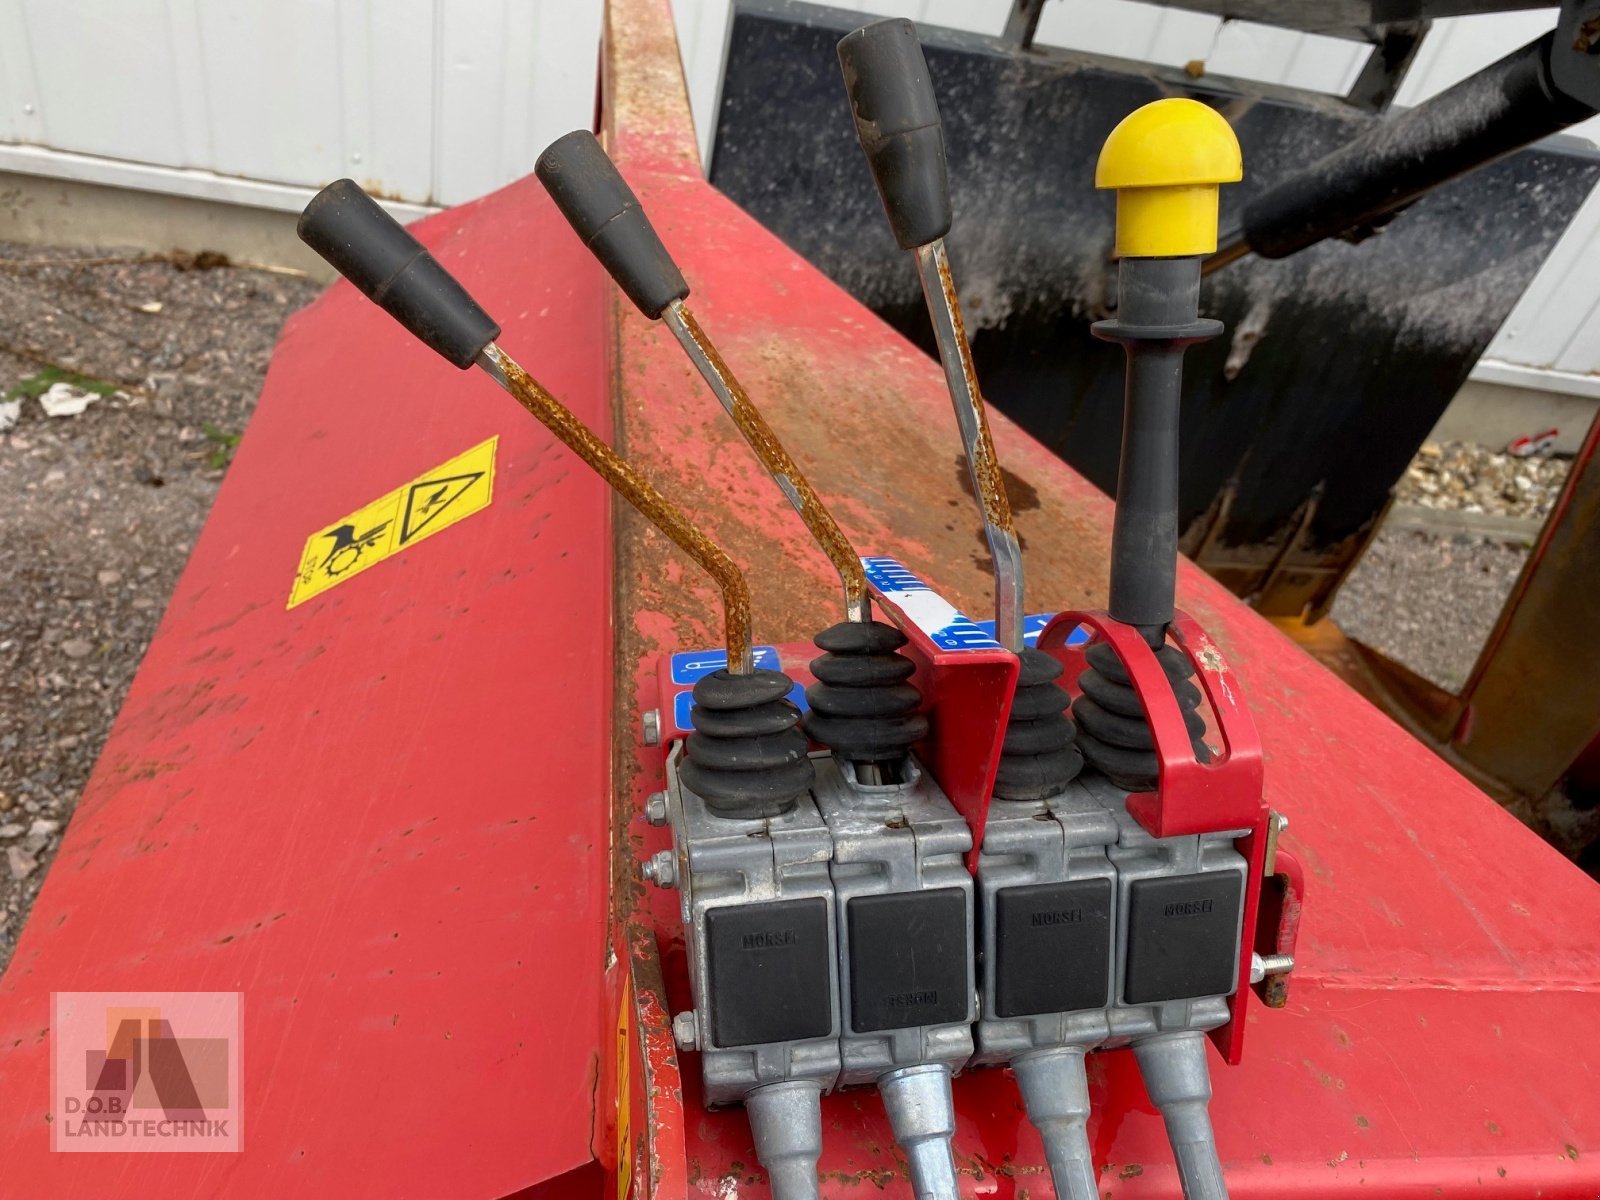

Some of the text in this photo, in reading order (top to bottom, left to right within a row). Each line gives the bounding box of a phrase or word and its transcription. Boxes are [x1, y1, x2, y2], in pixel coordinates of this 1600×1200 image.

[1031, 908, 1082, 927] MORSE
[1163, 899, 1213, 917] MORSE
[741, 929, 797, 949] MORSE
